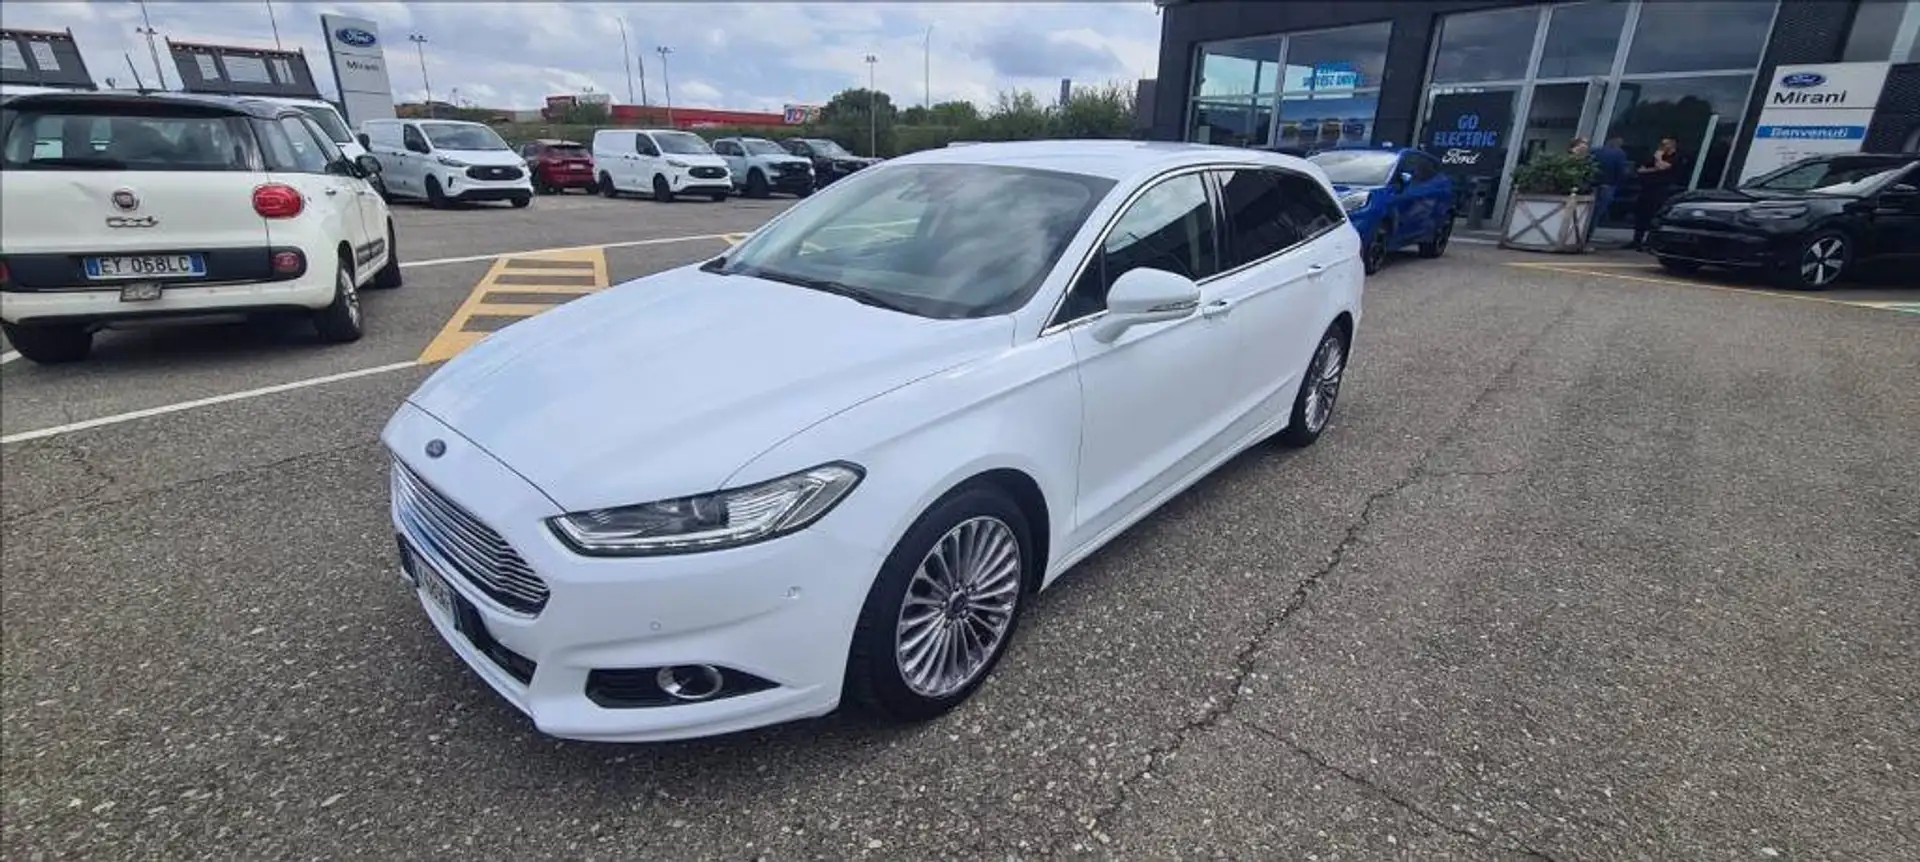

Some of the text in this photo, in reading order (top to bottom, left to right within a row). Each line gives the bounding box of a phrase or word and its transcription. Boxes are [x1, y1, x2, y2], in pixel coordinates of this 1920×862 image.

[1773, 90, 1847, 105] Mirani
[1457, 114, 1479, 130] GO
[1433, 130, 1498, 147] ELECTRIC
[1770, 126, 1848, 138] Benvenuti
[1441, 147, 1480, 164] Ford
[100, 257, 123, 273] EY
